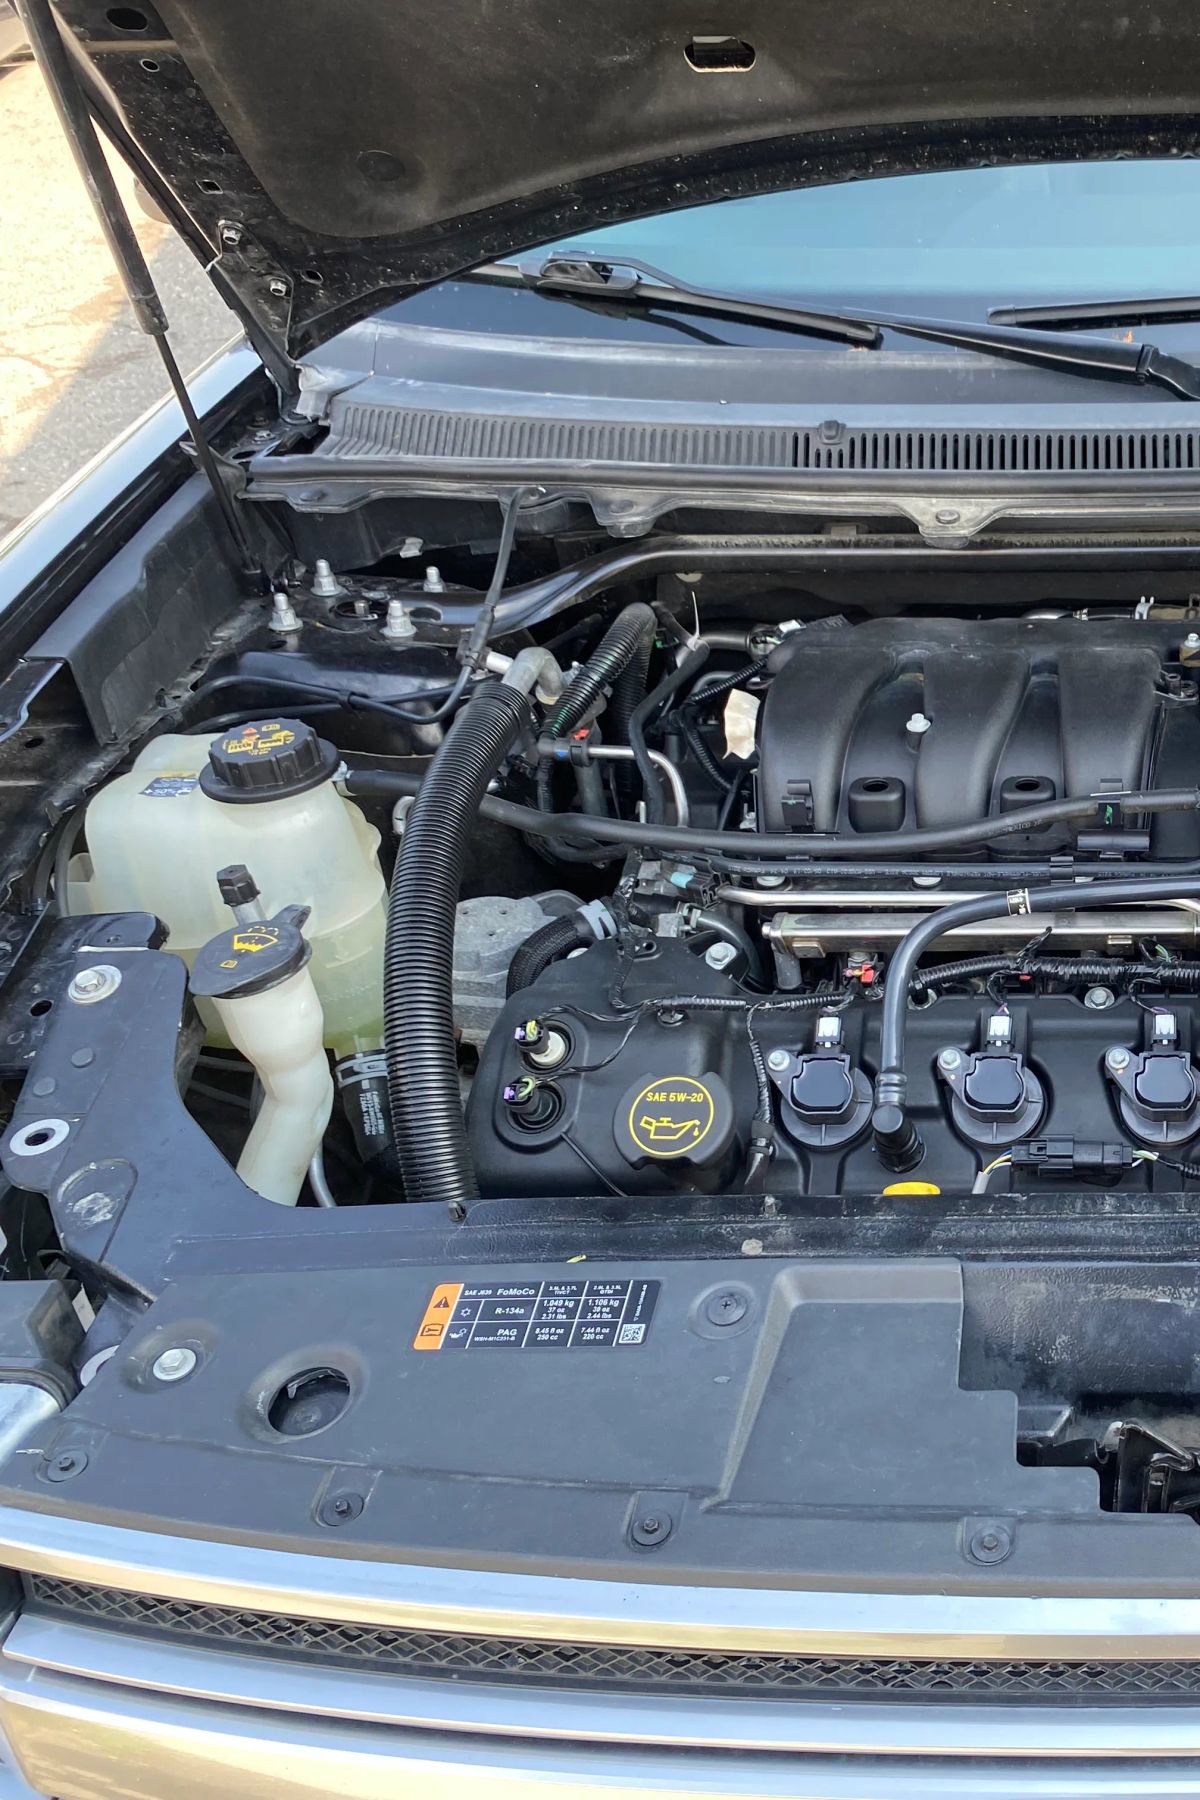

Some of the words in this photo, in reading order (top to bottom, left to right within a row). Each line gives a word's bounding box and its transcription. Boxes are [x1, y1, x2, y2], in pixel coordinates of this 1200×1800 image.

[646, 1092, 667, 1102] SAE
[669, 1092, 704, 1102] 5W-20
[497, 1288, 535, 1296] FoMoCo
[564, 1299, 575, 1307] kg
[609, 1298, 620, 1307] kg
[497, 1328, 518, 1336] PAG
